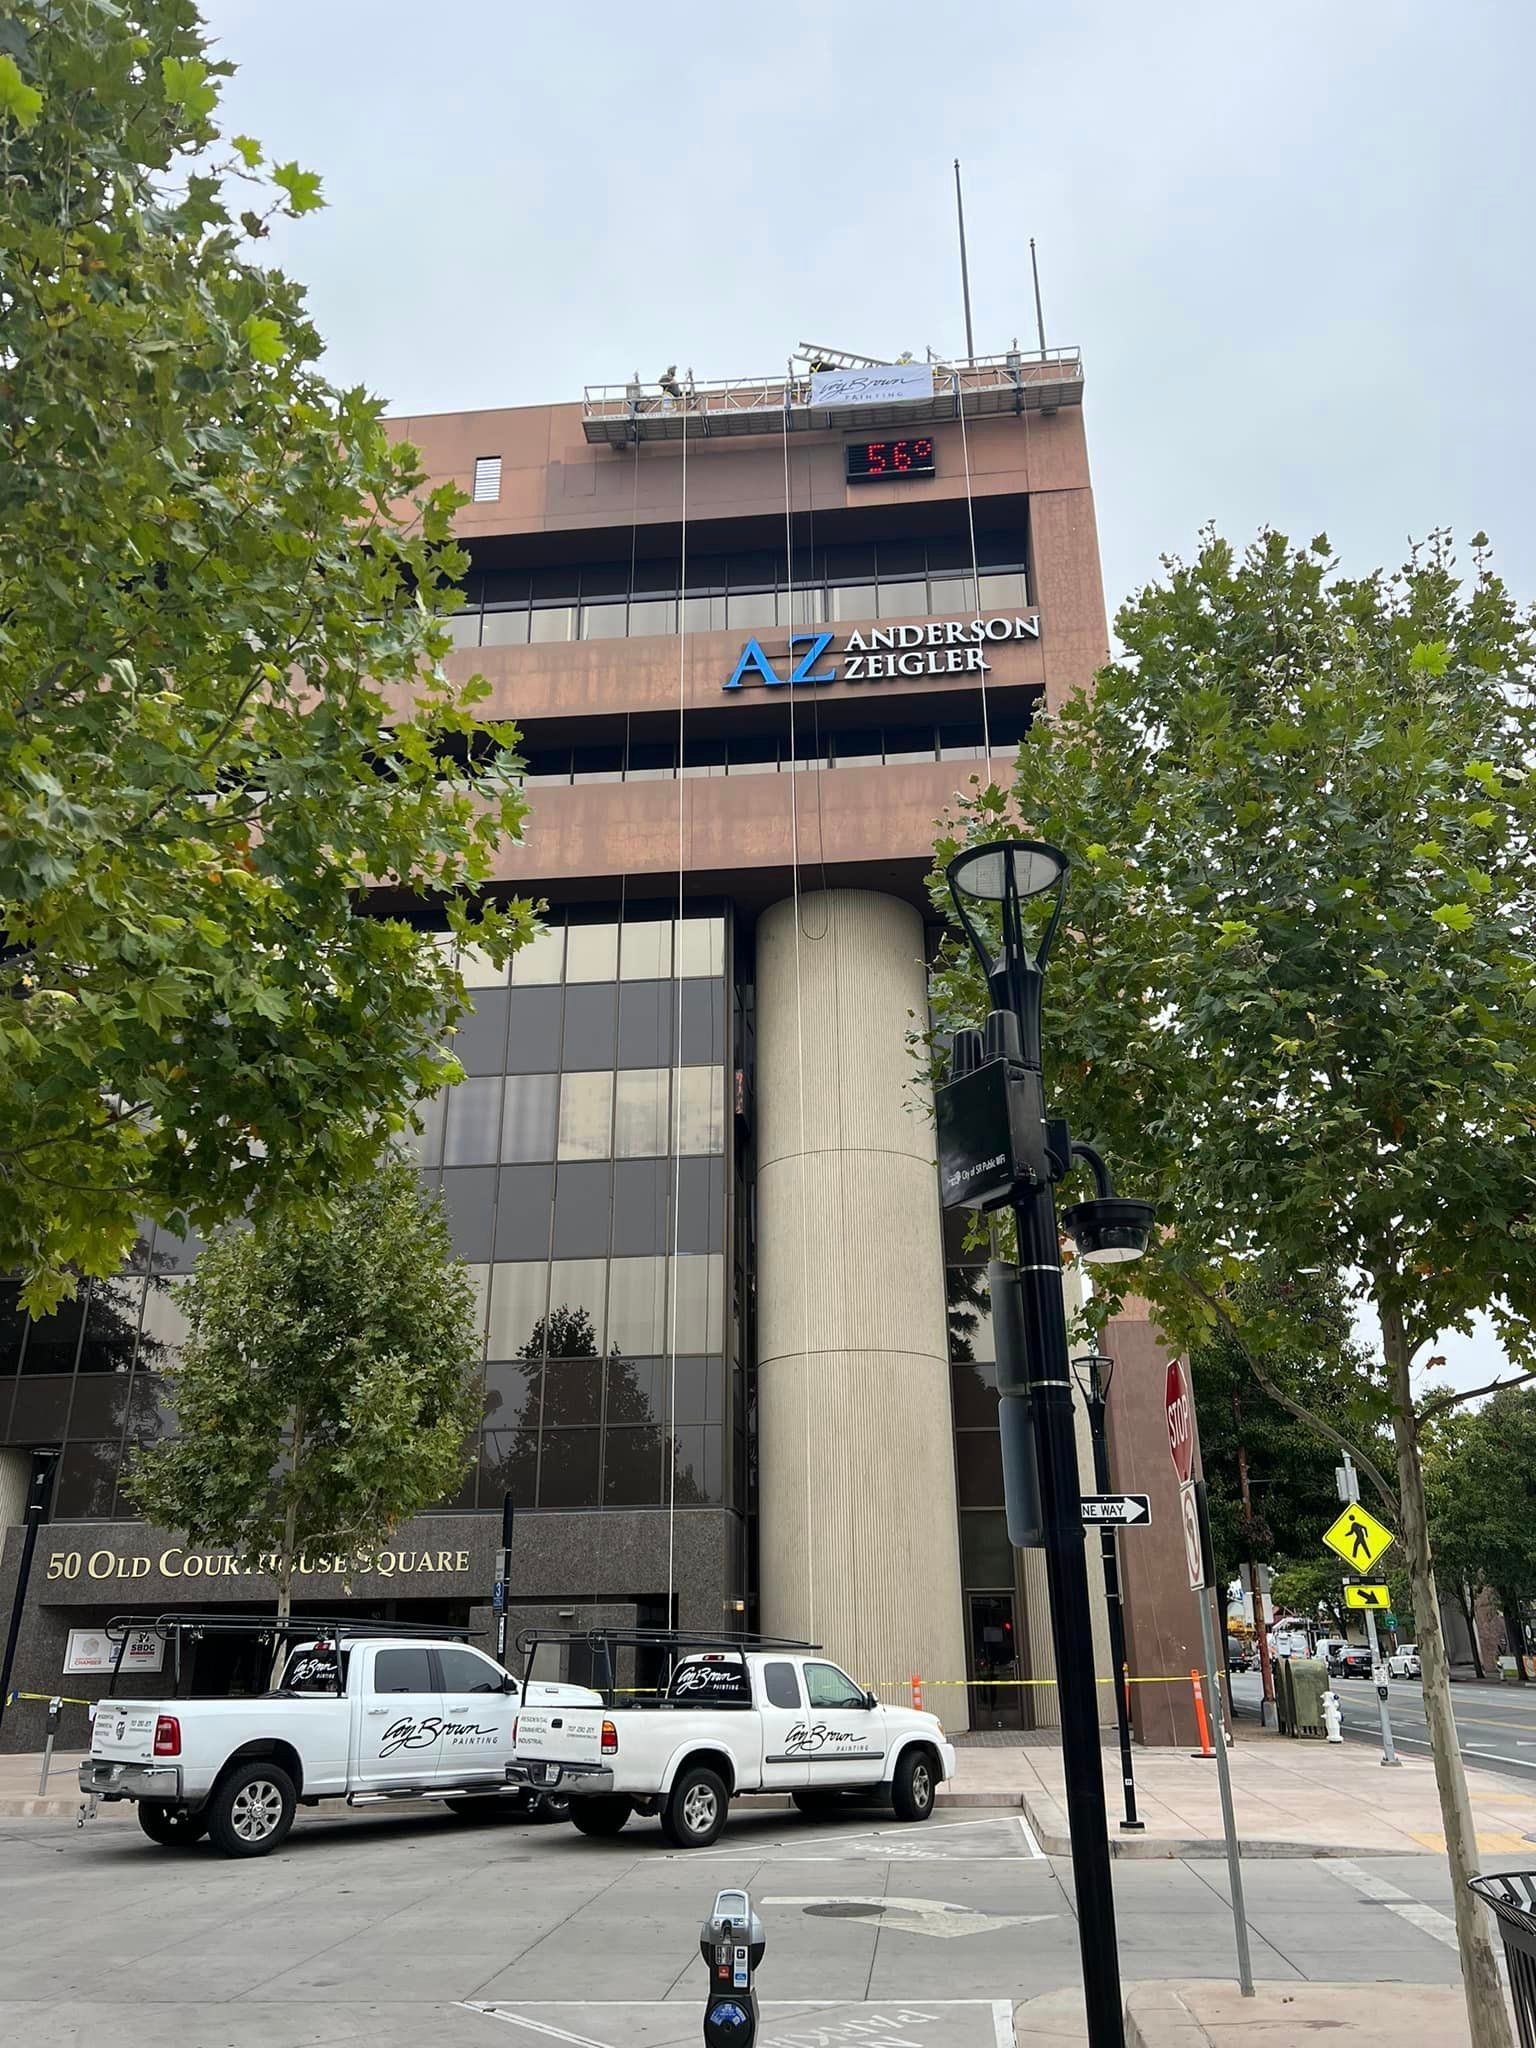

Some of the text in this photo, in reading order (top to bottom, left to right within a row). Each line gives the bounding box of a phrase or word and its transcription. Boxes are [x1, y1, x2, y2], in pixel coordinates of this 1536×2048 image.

[840, 377, 924, 395] Brown
[845, 392, 903, 400] PAINTING
[844, 615, 1041, 652] ANDERSON
[844, 647, 991, 680] ZEIGLER
[1167, 1395, 1189, 1449] STOP
[1082, 1503, 1124, 1516] NE WAY
[47, 1552, 82, 1579] 50
[88, 1550, 151, 1579] OLD
[131, 1644, 156, 1652] SBDC
[689, 1667, 741, 1690] Brown
[379, 1716, 499, 1758] Coy Brown
[452, 1736, 499, 1745] PAINTING
[784, 1724, 867, 1756] Coy Brown
